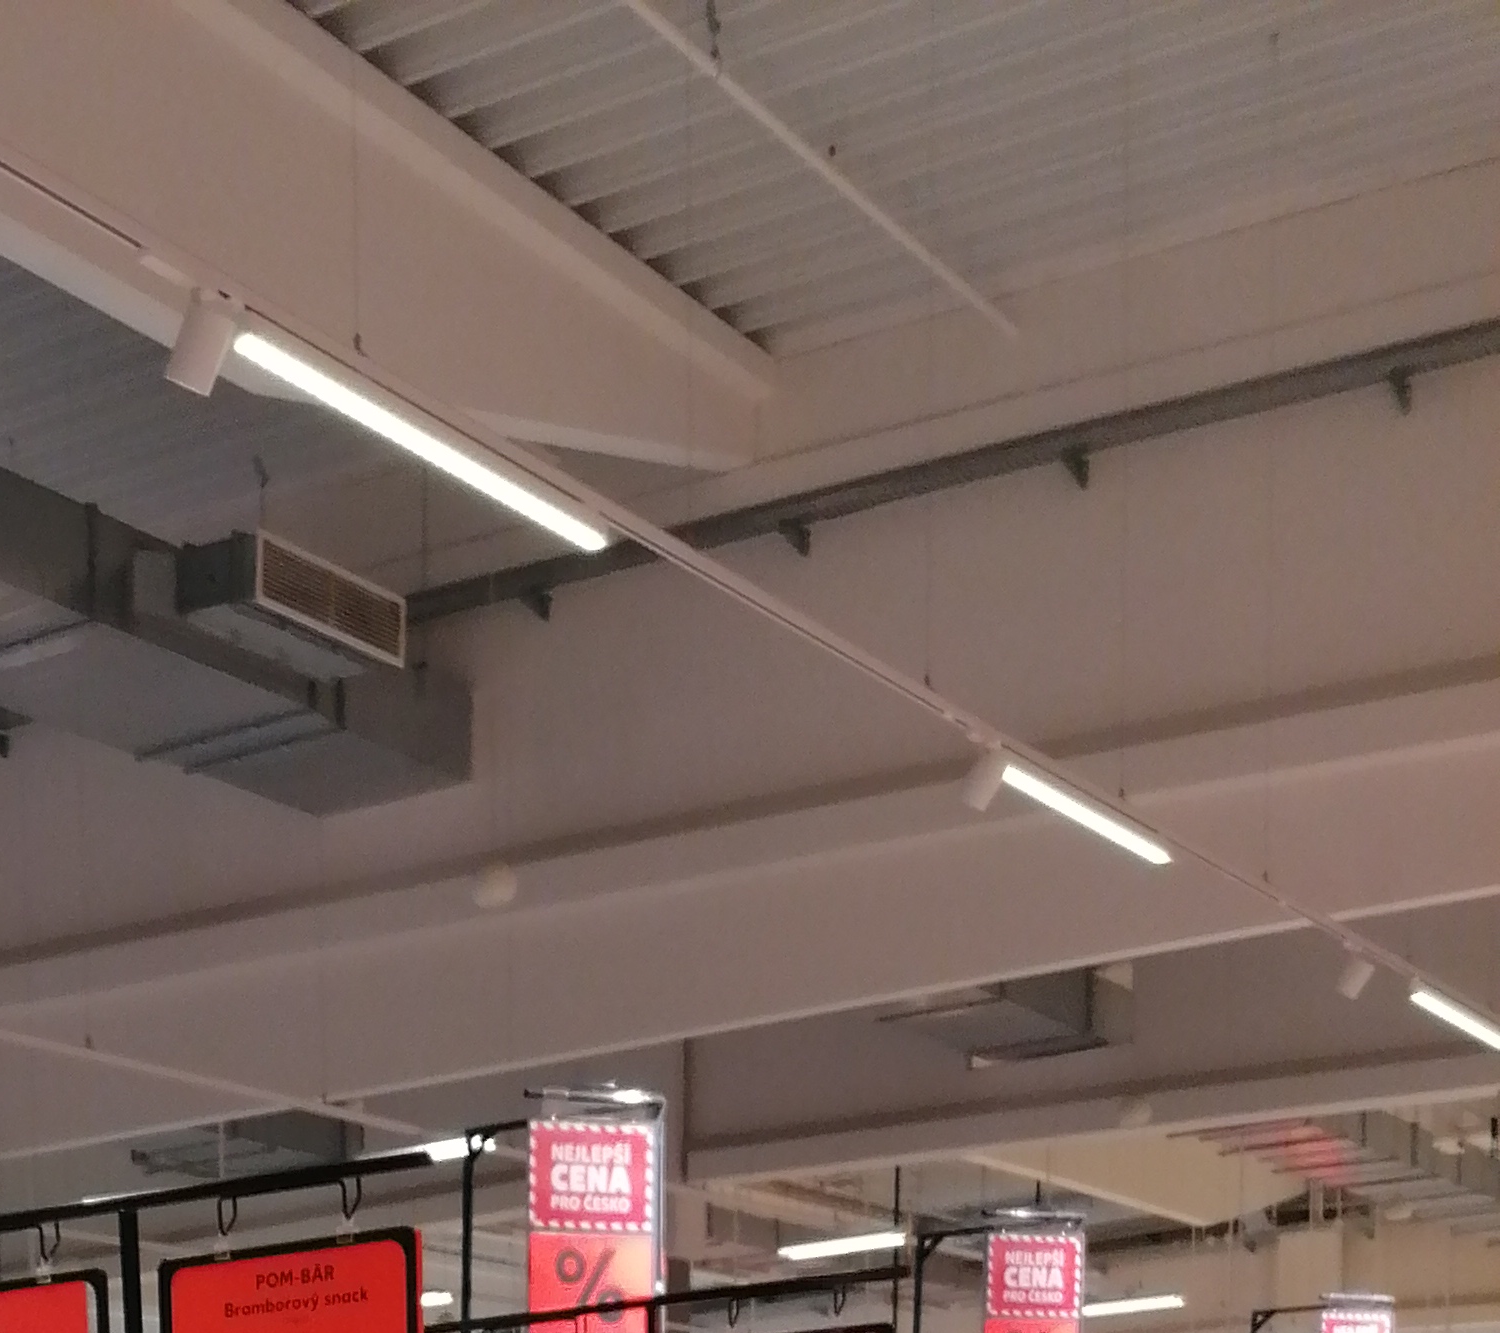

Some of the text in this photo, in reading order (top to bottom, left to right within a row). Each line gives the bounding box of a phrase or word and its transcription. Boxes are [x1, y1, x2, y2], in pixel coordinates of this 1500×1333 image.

[550, 1164, 631, 1195] CENA
[551, 1195, 580, 1213] PRO
[256, 1263, 335, 1290] POM-BÄR
[1003, 1267, 1064, 1290] CENA
[224, 1287, 368, 1318] Bramborový snack
